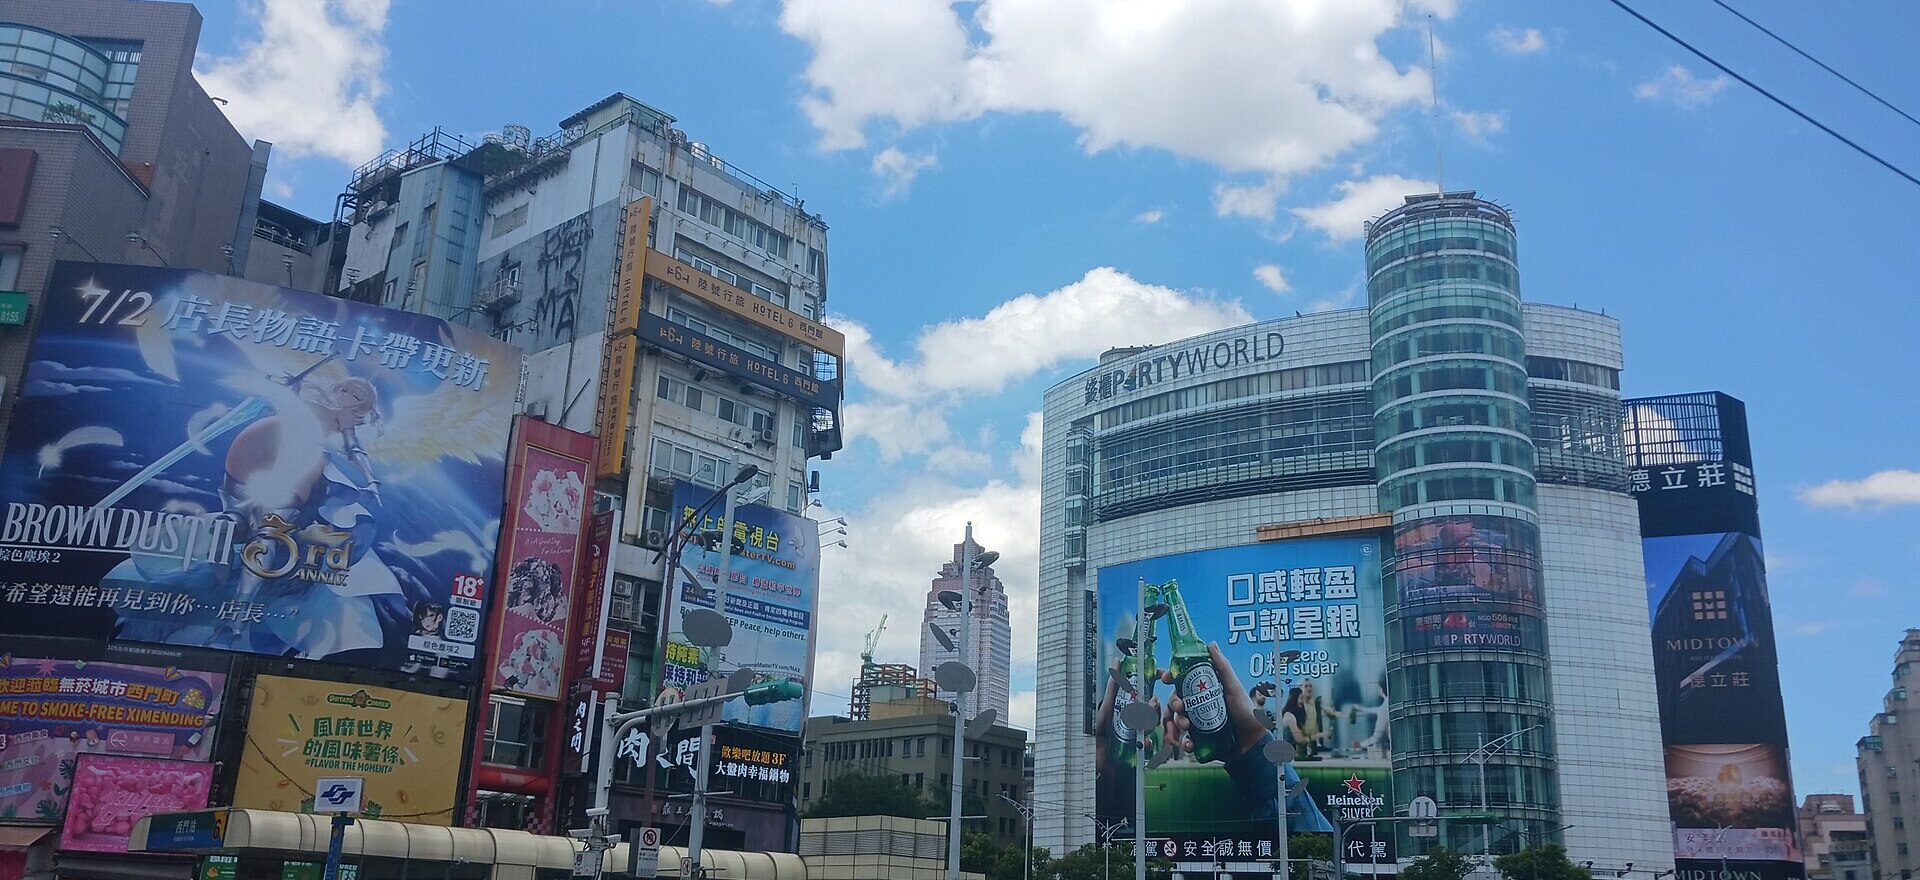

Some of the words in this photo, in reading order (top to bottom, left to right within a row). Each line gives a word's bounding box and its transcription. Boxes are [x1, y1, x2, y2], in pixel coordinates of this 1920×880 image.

[698, 277, 745, 307] 陸號行旅
[753, 302, 784, 325] HOTEL
[788, 318, 794, 329] 6
[79, 288, 153, 327] 7/2
[160, 294, 490, 391] 店長物語卡帶更新
[691, 337, 740, 366] 陸號行旅
[748, 359, 780, 382] HOTEL
[783, 373, 789, 385] 6
[1630, 462, 1726, 492] 德立莊
[1, 502, 115, 548] BROWN
[114, 508, 213, 571] DUST
[207, 518, 237, 565] II
[241, 513, 353, 578] 3rd
[740, 548, 796, 571] sterTV.com
[455, 575, 484, 597] 18+
[1227, 565, 1357, 606] 口感輕盈
[740, 620, 762, 633] Peace,
[764, 625, 781, 638] help
[782, 630, 806, 641] others.
[1228, 604, 1360, 644] 只認星銀
[1451, 633, 1521, 647] PRTYWORLD
[1667, 637, 1759, 651] MIDTOWN
[666, 641, 699, 664] 持純素
[1293, 661, 1339, 678] sugar
[22, 701, 38, 716] TO
[41, 701, 123, 721] SMOKE-FREE
[126, 707, 204, 726] XIMENDING
[313, 716, 393, 740] 風靡世界
[303, 739, 399, 764] 的風味薯條
[771, 752, 787, 766] 3F
[305, 759, 339, 769] #FLAVOR
[342, 761, 358, 771] THE
[357, 763, 393, 774] MOMENT#
[715, 761, 790, 784] 大盤肉幸福鍋物
[661, 802, 724, 820] 鼎王鍋
[1327, 794, 1384, 806] Heineken
[1342, 807, 1374, 819] SILVER
[212, 818, 222, 841] 6
[1183, 839, 1273, 857] 安全誠無價
[1348, 840, 1387, 857] 代駕
